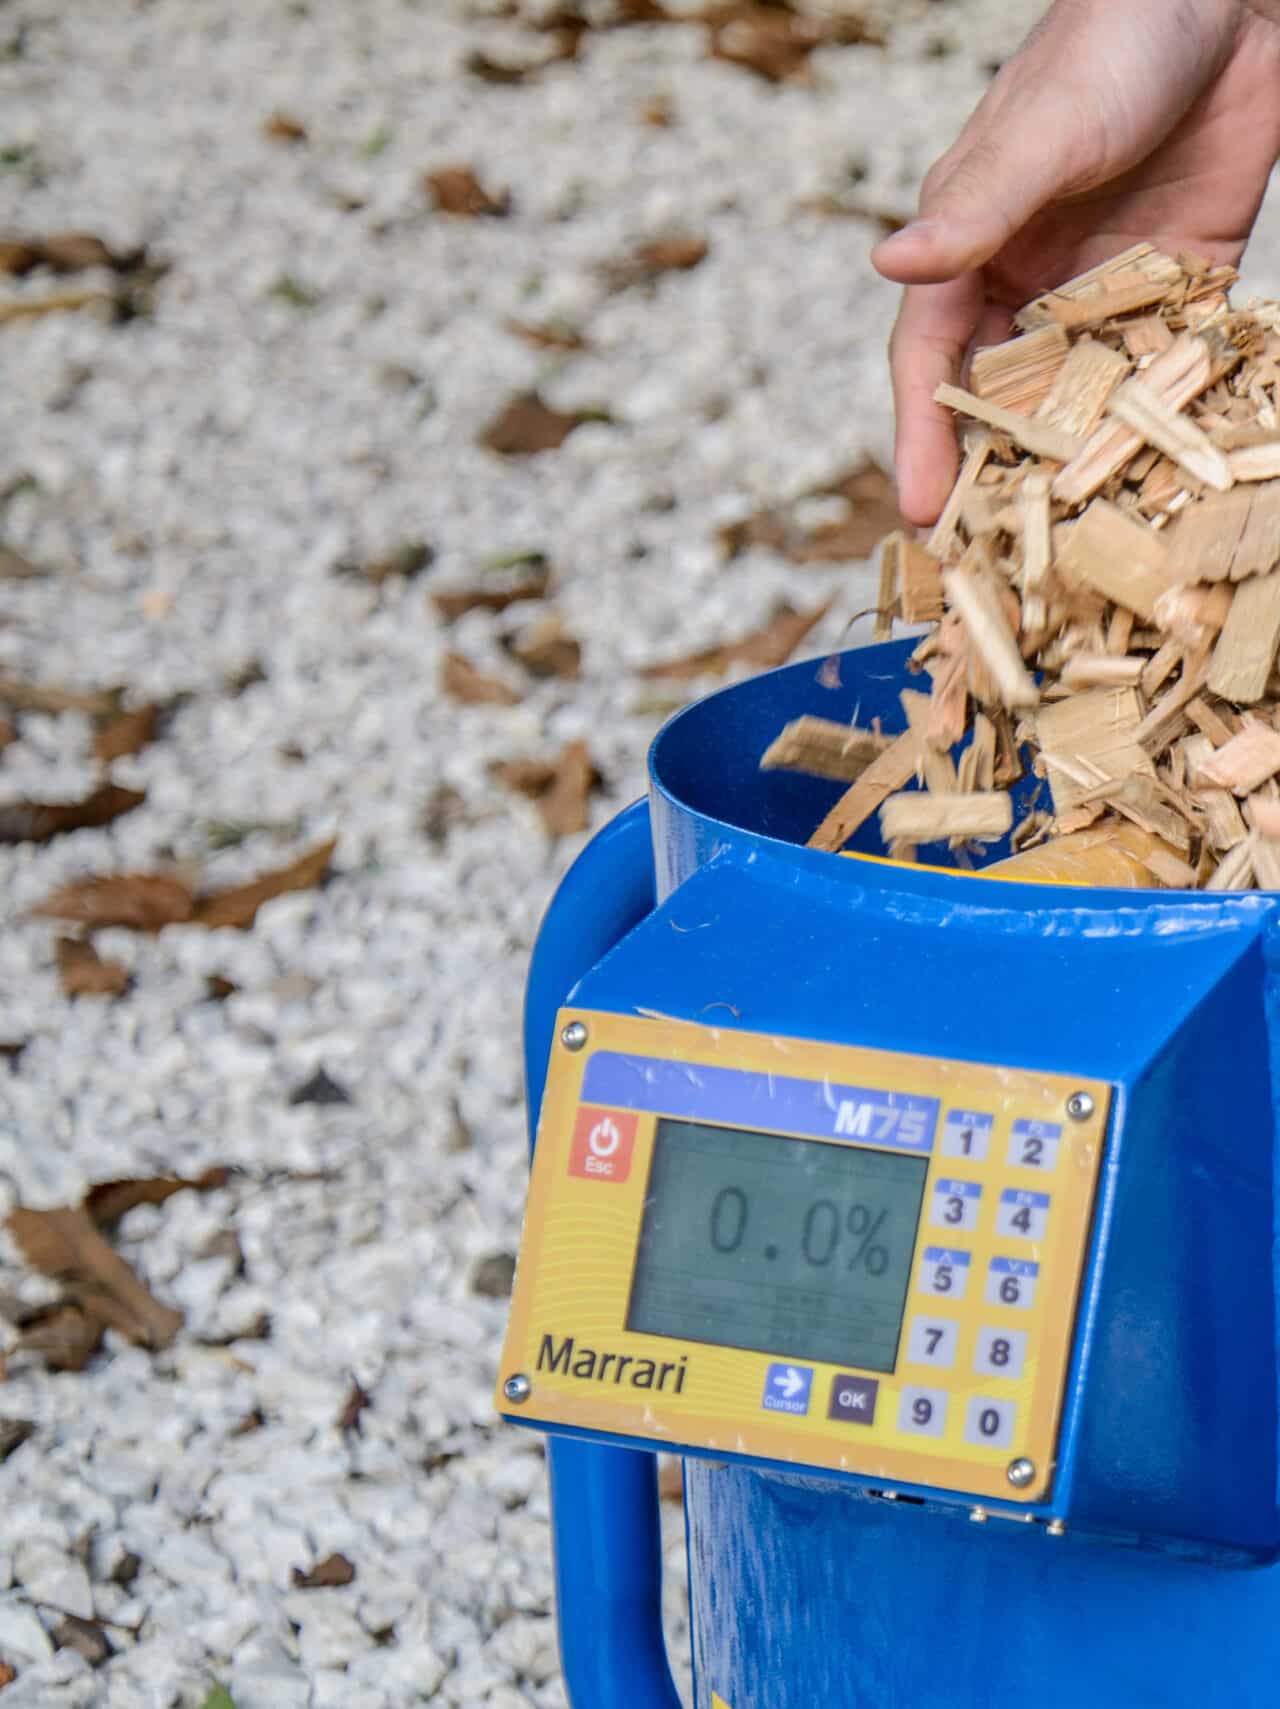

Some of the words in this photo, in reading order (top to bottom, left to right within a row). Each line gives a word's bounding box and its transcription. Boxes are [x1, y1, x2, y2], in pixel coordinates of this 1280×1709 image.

[833, 1099, 928, 1145] M75
[959, 1128, 974, 1156] 1
[1021, 1137, 1044, 1166] 2
[584, 1155, 615, 1175] Esc
[943, 1196, 965, 1225] 3
[1010, 1206, 1032, 1234] 4
[932, 1264, 953, 1293] 5
[999, 1276, 1021, 1304] 6
[924, 1327, 944, 1356] 7
[988, 1337, 1011, 1367] 8
[536, 1333, 688, 1394] Marrari
[763, 1394, 807, 1413] Cursor
[838, 1389, 867, 1409] OK
[911, 1397, 933, 1426] 9
[978, 1407, 1001, 1437] 0
